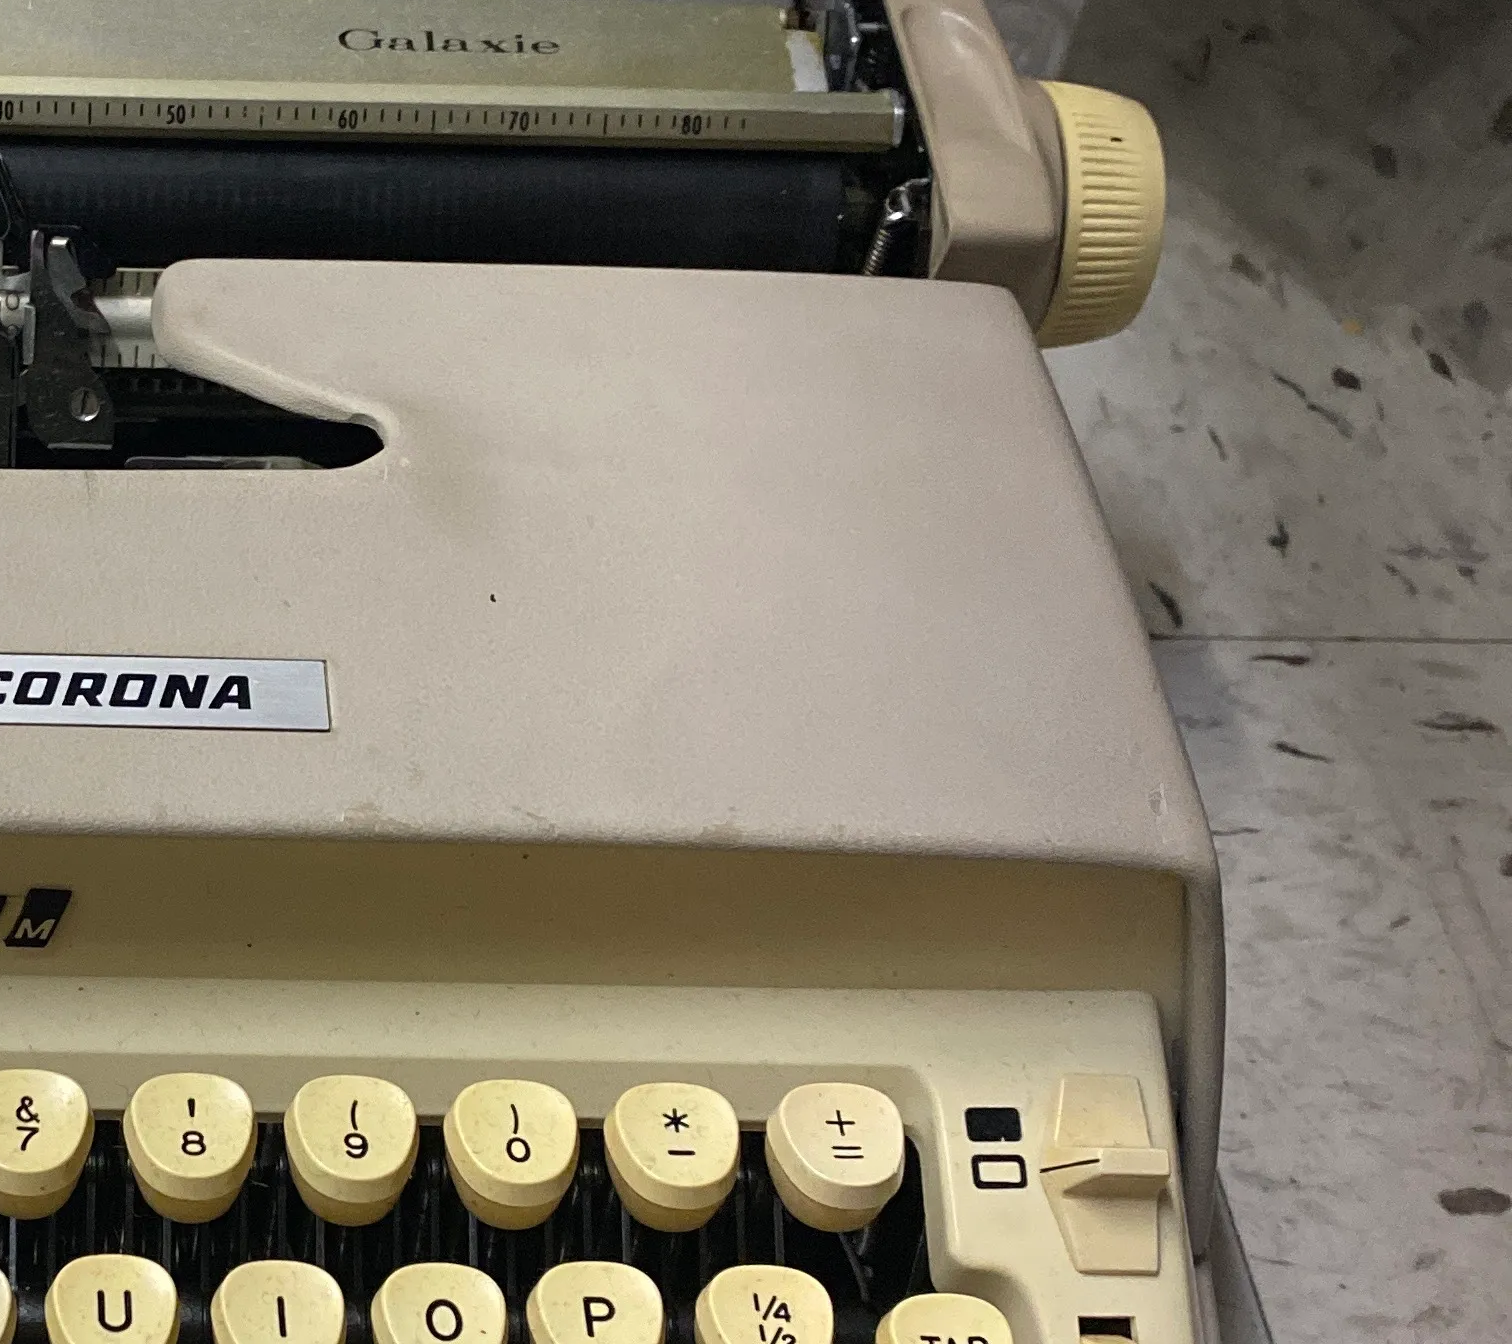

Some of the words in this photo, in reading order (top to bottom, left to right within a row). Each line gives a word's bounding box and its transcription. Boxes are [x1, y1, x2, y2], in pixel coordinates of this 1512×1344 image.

[338, 28, 560, 55] Galaxie
[166, 105, 186, 125] 50
[338, 109, 358, 130] 60
[508, 111, 529, 131] 70
[681, 115, 701, 135] 80
[15, 1096, 40, 1123] &
[825, 1109, 855, 1136] +
[16, 1127, 39, 1151] 7
[181, 1131, 206, 1156] 8
[344, 1133, 368, 1158] 9
[96, 1289, 132, 1333] U
[276, 1296, 287, 1337] I
[425, 1299, 464, 1341] O
[583, 1296, 616, 1338] P
